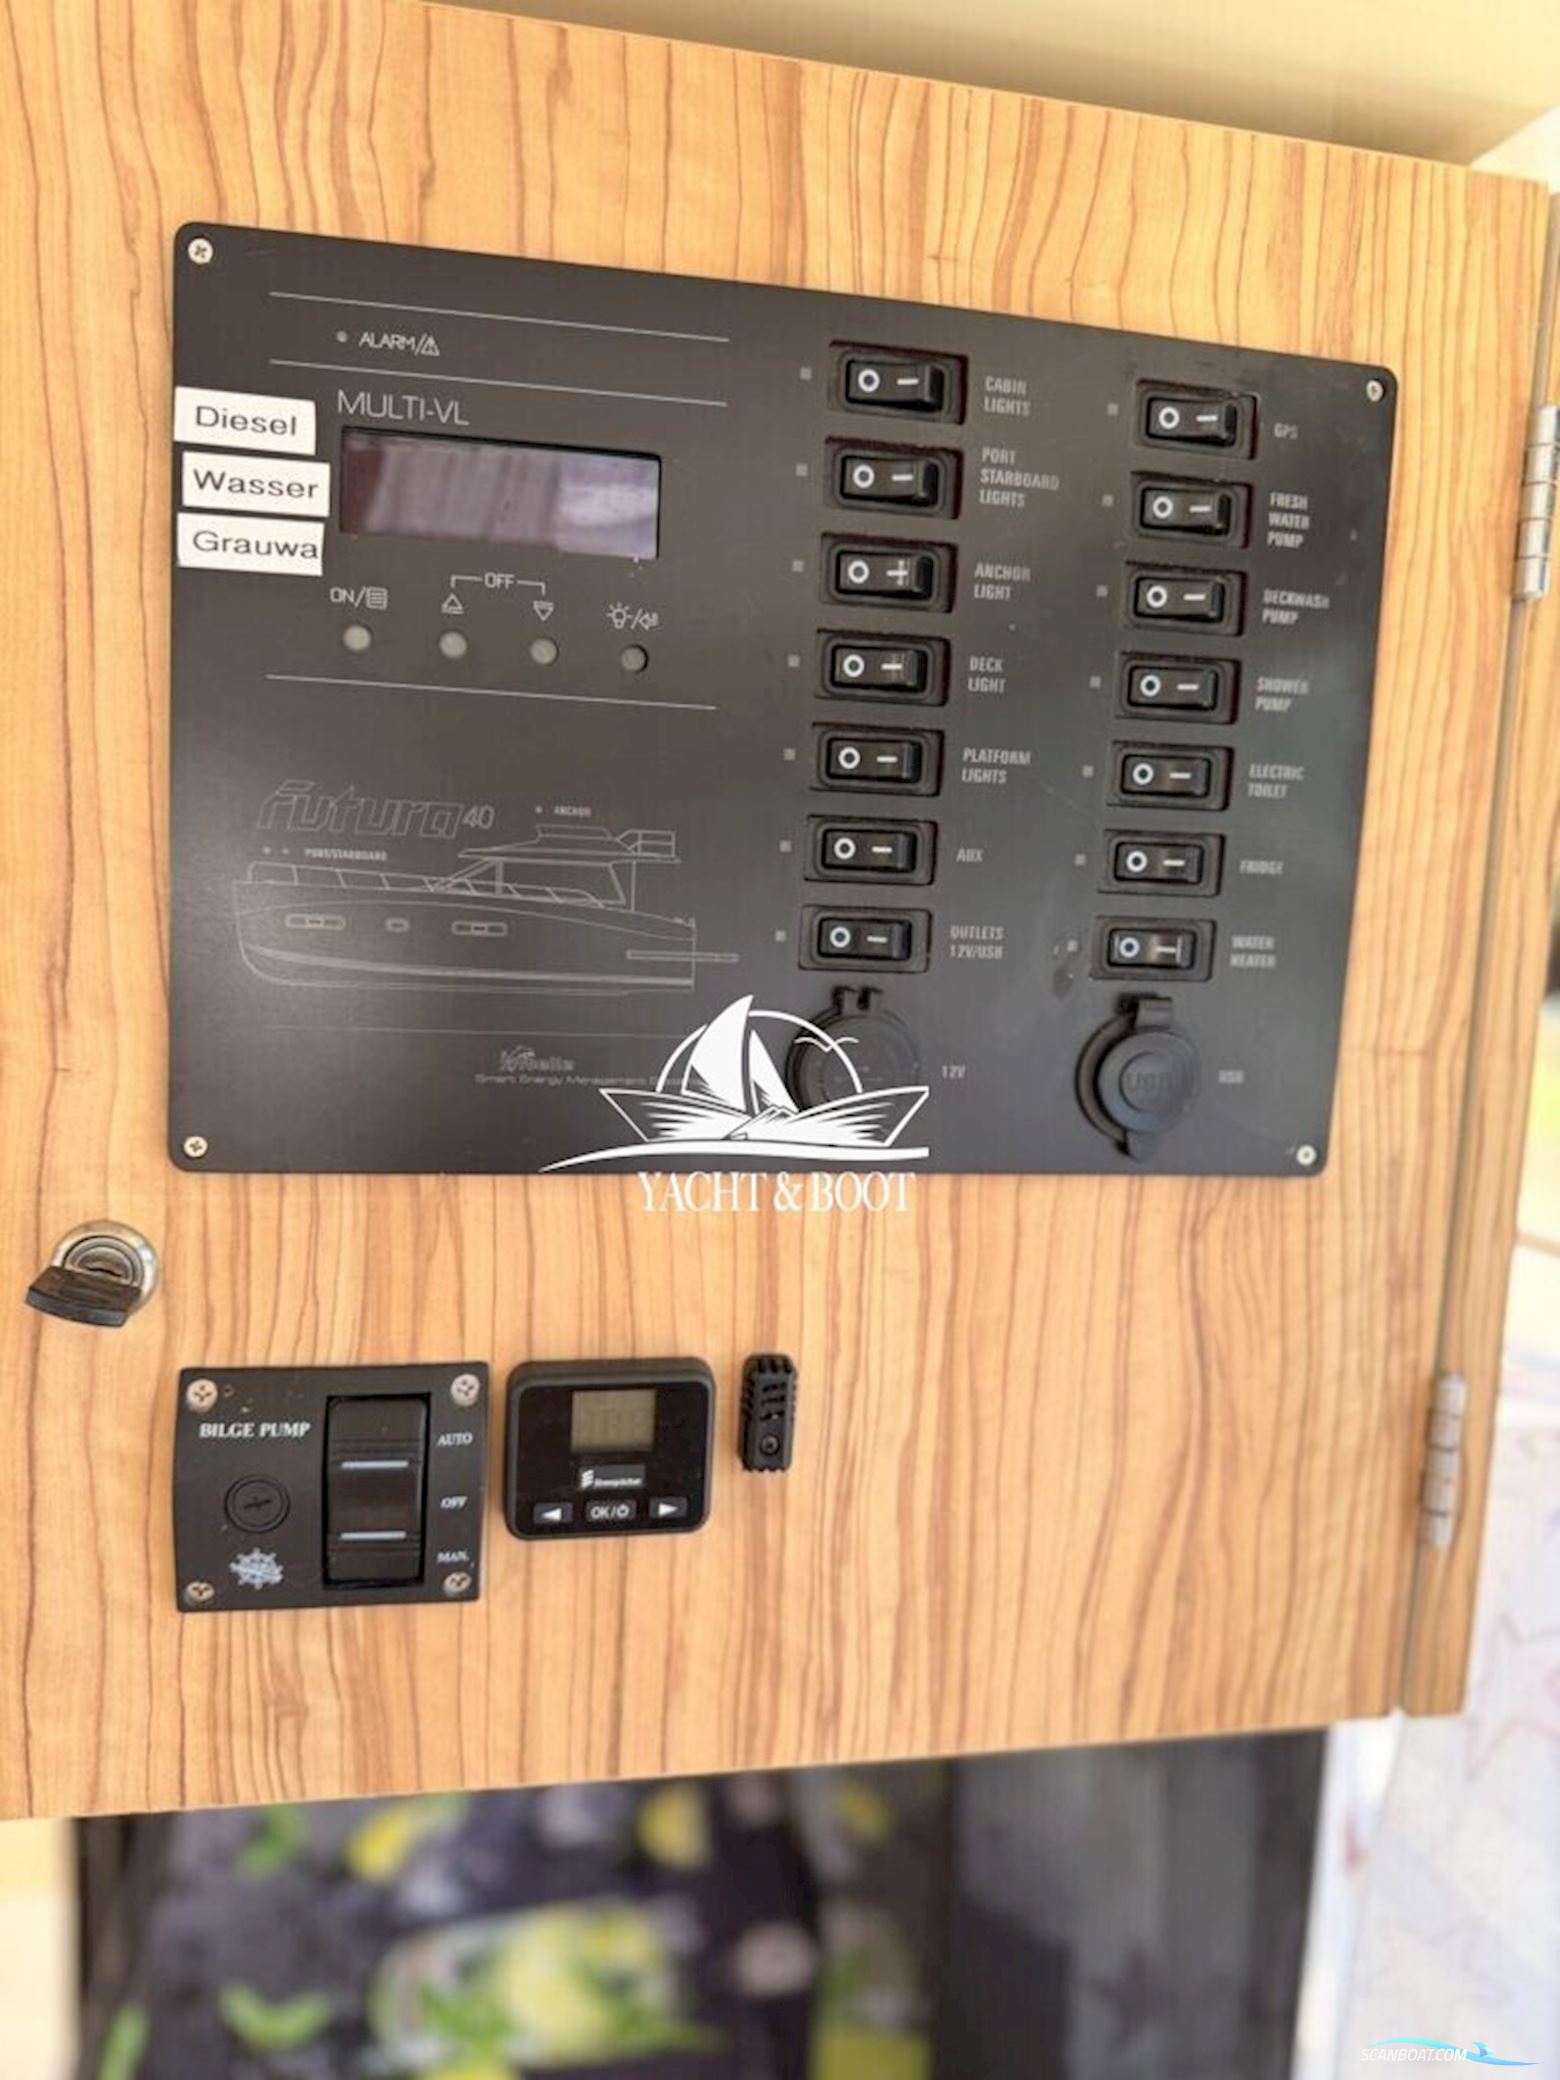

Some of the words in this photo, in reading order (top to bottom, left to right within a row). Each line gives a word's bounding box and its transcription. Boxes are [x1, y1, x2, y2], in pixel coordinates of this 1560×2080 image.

[985, 376, 1027, 395] CABIN
[337, 389, 470, 426] MULTI-VL
[984, 397, 1031, 417] LIGHTS
[195, 405, 298, 437] Diesel
[1273, 422, 1299, 440] GPS
[982, 448, 1016, 466] PORT
[193, 468, 320, 500] Wasser
[980, 469, 1060, 491] STARBOARD
[979, 490, 1026, 509] LIGHTS
[1270, 492, 1309, 510] FRESH
[1268, 512, 1310, 530] WATER
[192, 530, 319, 560] Grauwa
[1267, 532, 1304, 550] PUMP
[974, 563, 1031, 582] ANCHOR
[483, 572, 515, 592] OFF
[973, 584, 1012, 602] LIGHT
[1262, 609, 1299, 626] PUMP
[969, 656, 1003, 673] DECK
[967, 677, 1006, 694] LIGHT
[1256, 677, 1309, 695] SHOWER
[1255, 696, 1292, 713] PUMP
[963, 747, 1031, 766] PLATFORM
[961, 768, 1008, 785] LIGHTS
[1249, 763, 1305, 781] ELECTRIC
[1248, 782, 1288, 799] TOILET
[463, 804, 496, 830] 40
[956, 847, 983, 863] AUX
[1239, 858, 1285, 876] FRIDGE
[950, 924, 1004, 941] OUTLETS
[942, 1064, 966, 1080] 12V
[198, 1422, 256, 1439] BILGE
[258, 1421, 312, 1438] PUMP
[436, 1431, 474, 1447] AUTO
[440, 1495, 469, 1510] OFF
